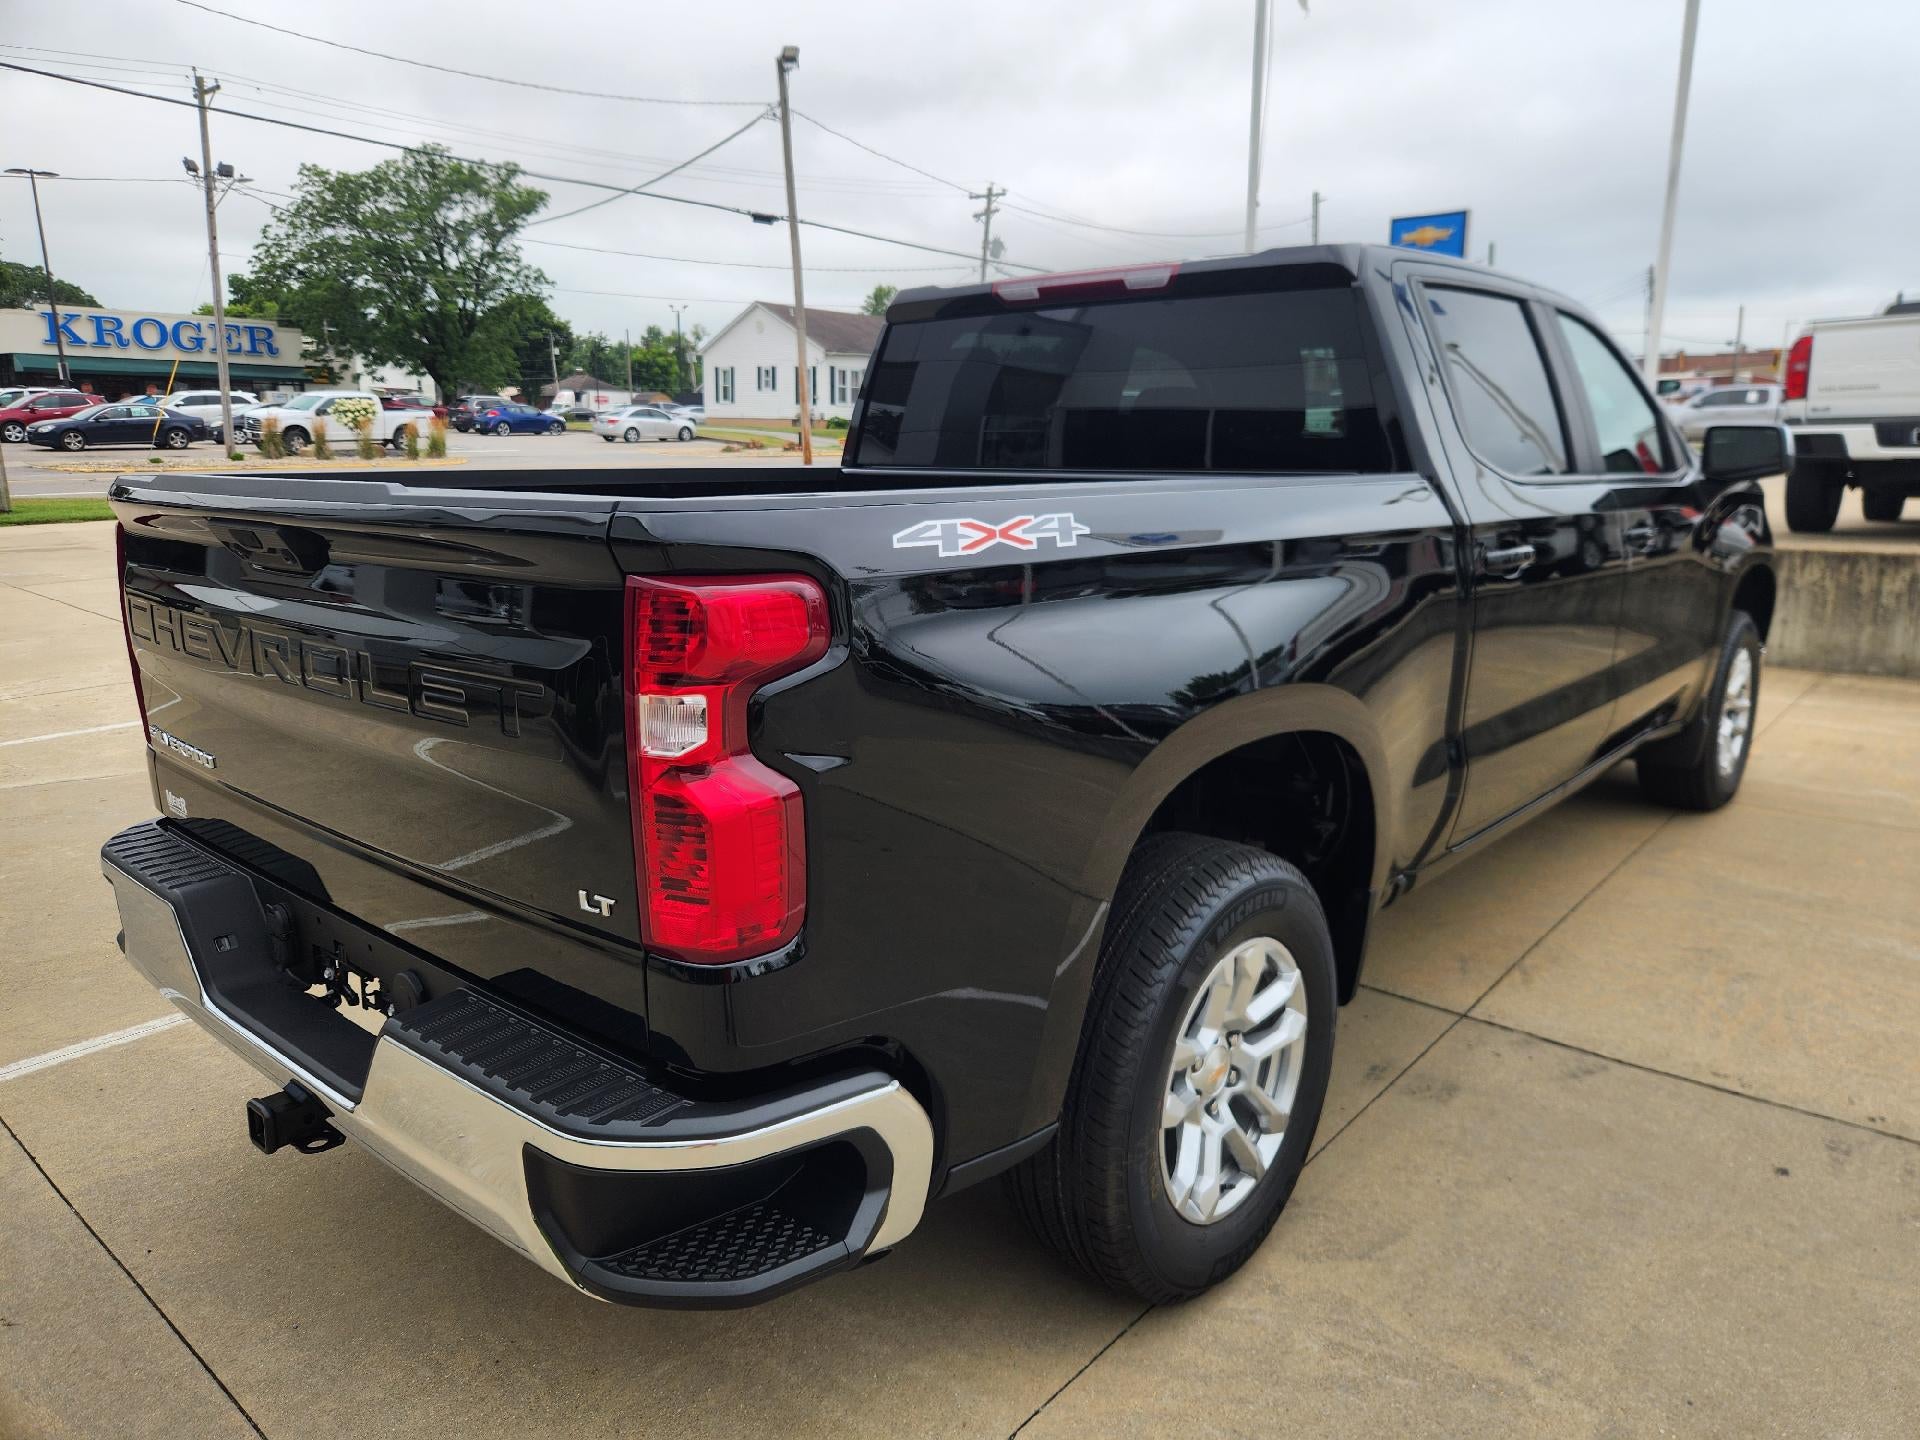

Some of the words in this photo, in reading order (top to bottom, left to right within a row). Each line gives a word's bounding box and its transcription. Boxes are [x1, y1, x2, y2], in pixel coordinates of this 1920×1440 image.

[40, 311, 280, 358] KROGER
[127, 597, 545, 738] CHEVROLET
[578, 889, 616, 917] LT
